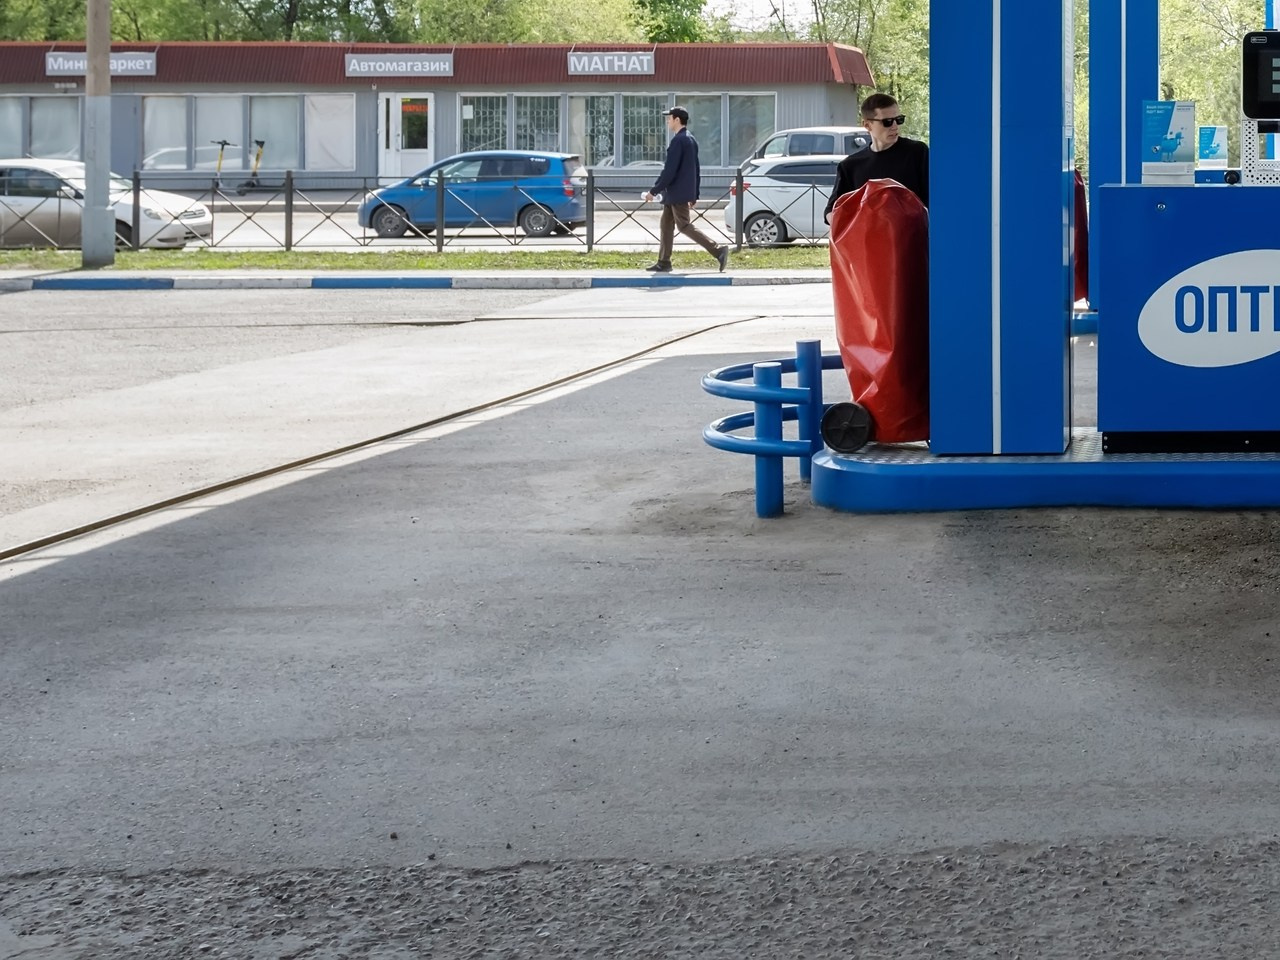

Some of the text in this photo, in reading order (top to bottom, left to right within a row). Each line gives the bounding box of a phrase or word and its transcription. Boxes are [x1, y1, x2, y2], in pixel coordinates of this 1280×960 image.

[47, 57, 152, 72] Минаркет
[349, 58, 450, 72] Автомагазин
[569, 55, 651, 71] МАГНАТ
